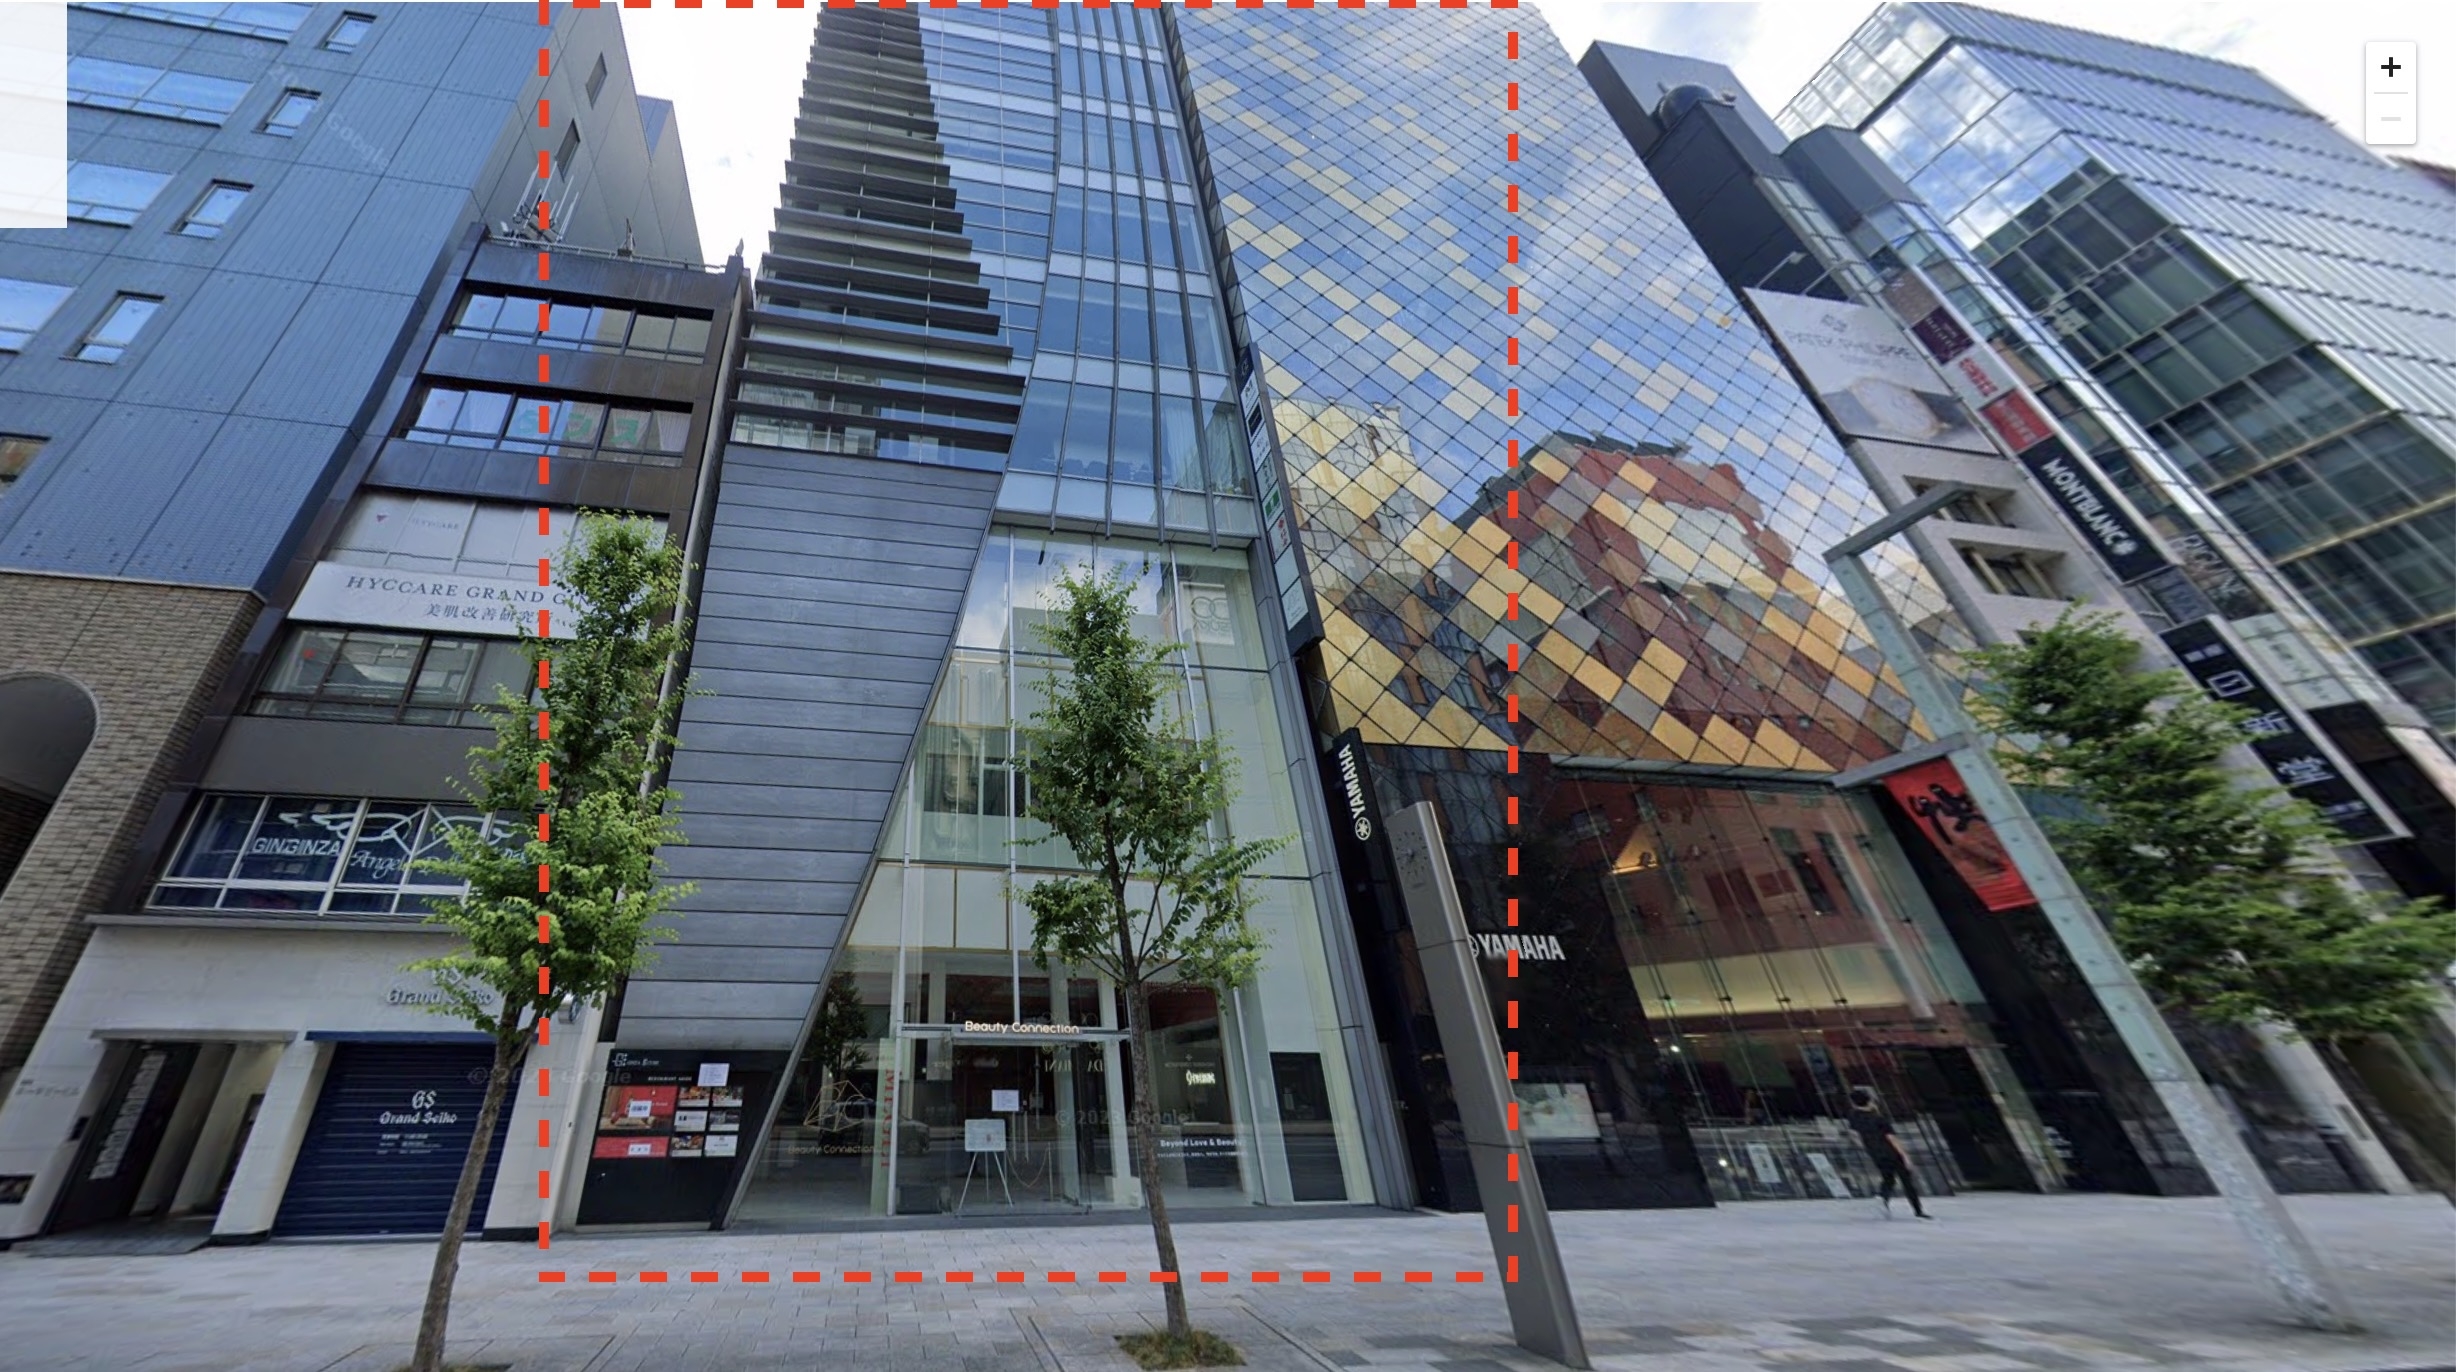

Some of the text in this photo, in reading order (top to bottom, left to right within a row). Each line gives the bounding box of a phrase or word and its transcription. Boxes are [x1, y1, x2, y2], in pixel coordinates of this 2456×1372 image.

[2041, 458, 2129, 546] MONTBLANC
[345, 575, 459, 598] HYCCARE
[466, 585, 545, 604] GRAND
[426, 603, 553, 625] 美肌改善研究
[1338, 743, 1366, 819] YAMAHA
[1476, 933, 1566, 961] YAMAHA
[965, 1020, 1080, 1035] Beauty Connection
[411, 1089, 437, 1110] GS
[379, 1110, 458, 1125] Grand Seiko
